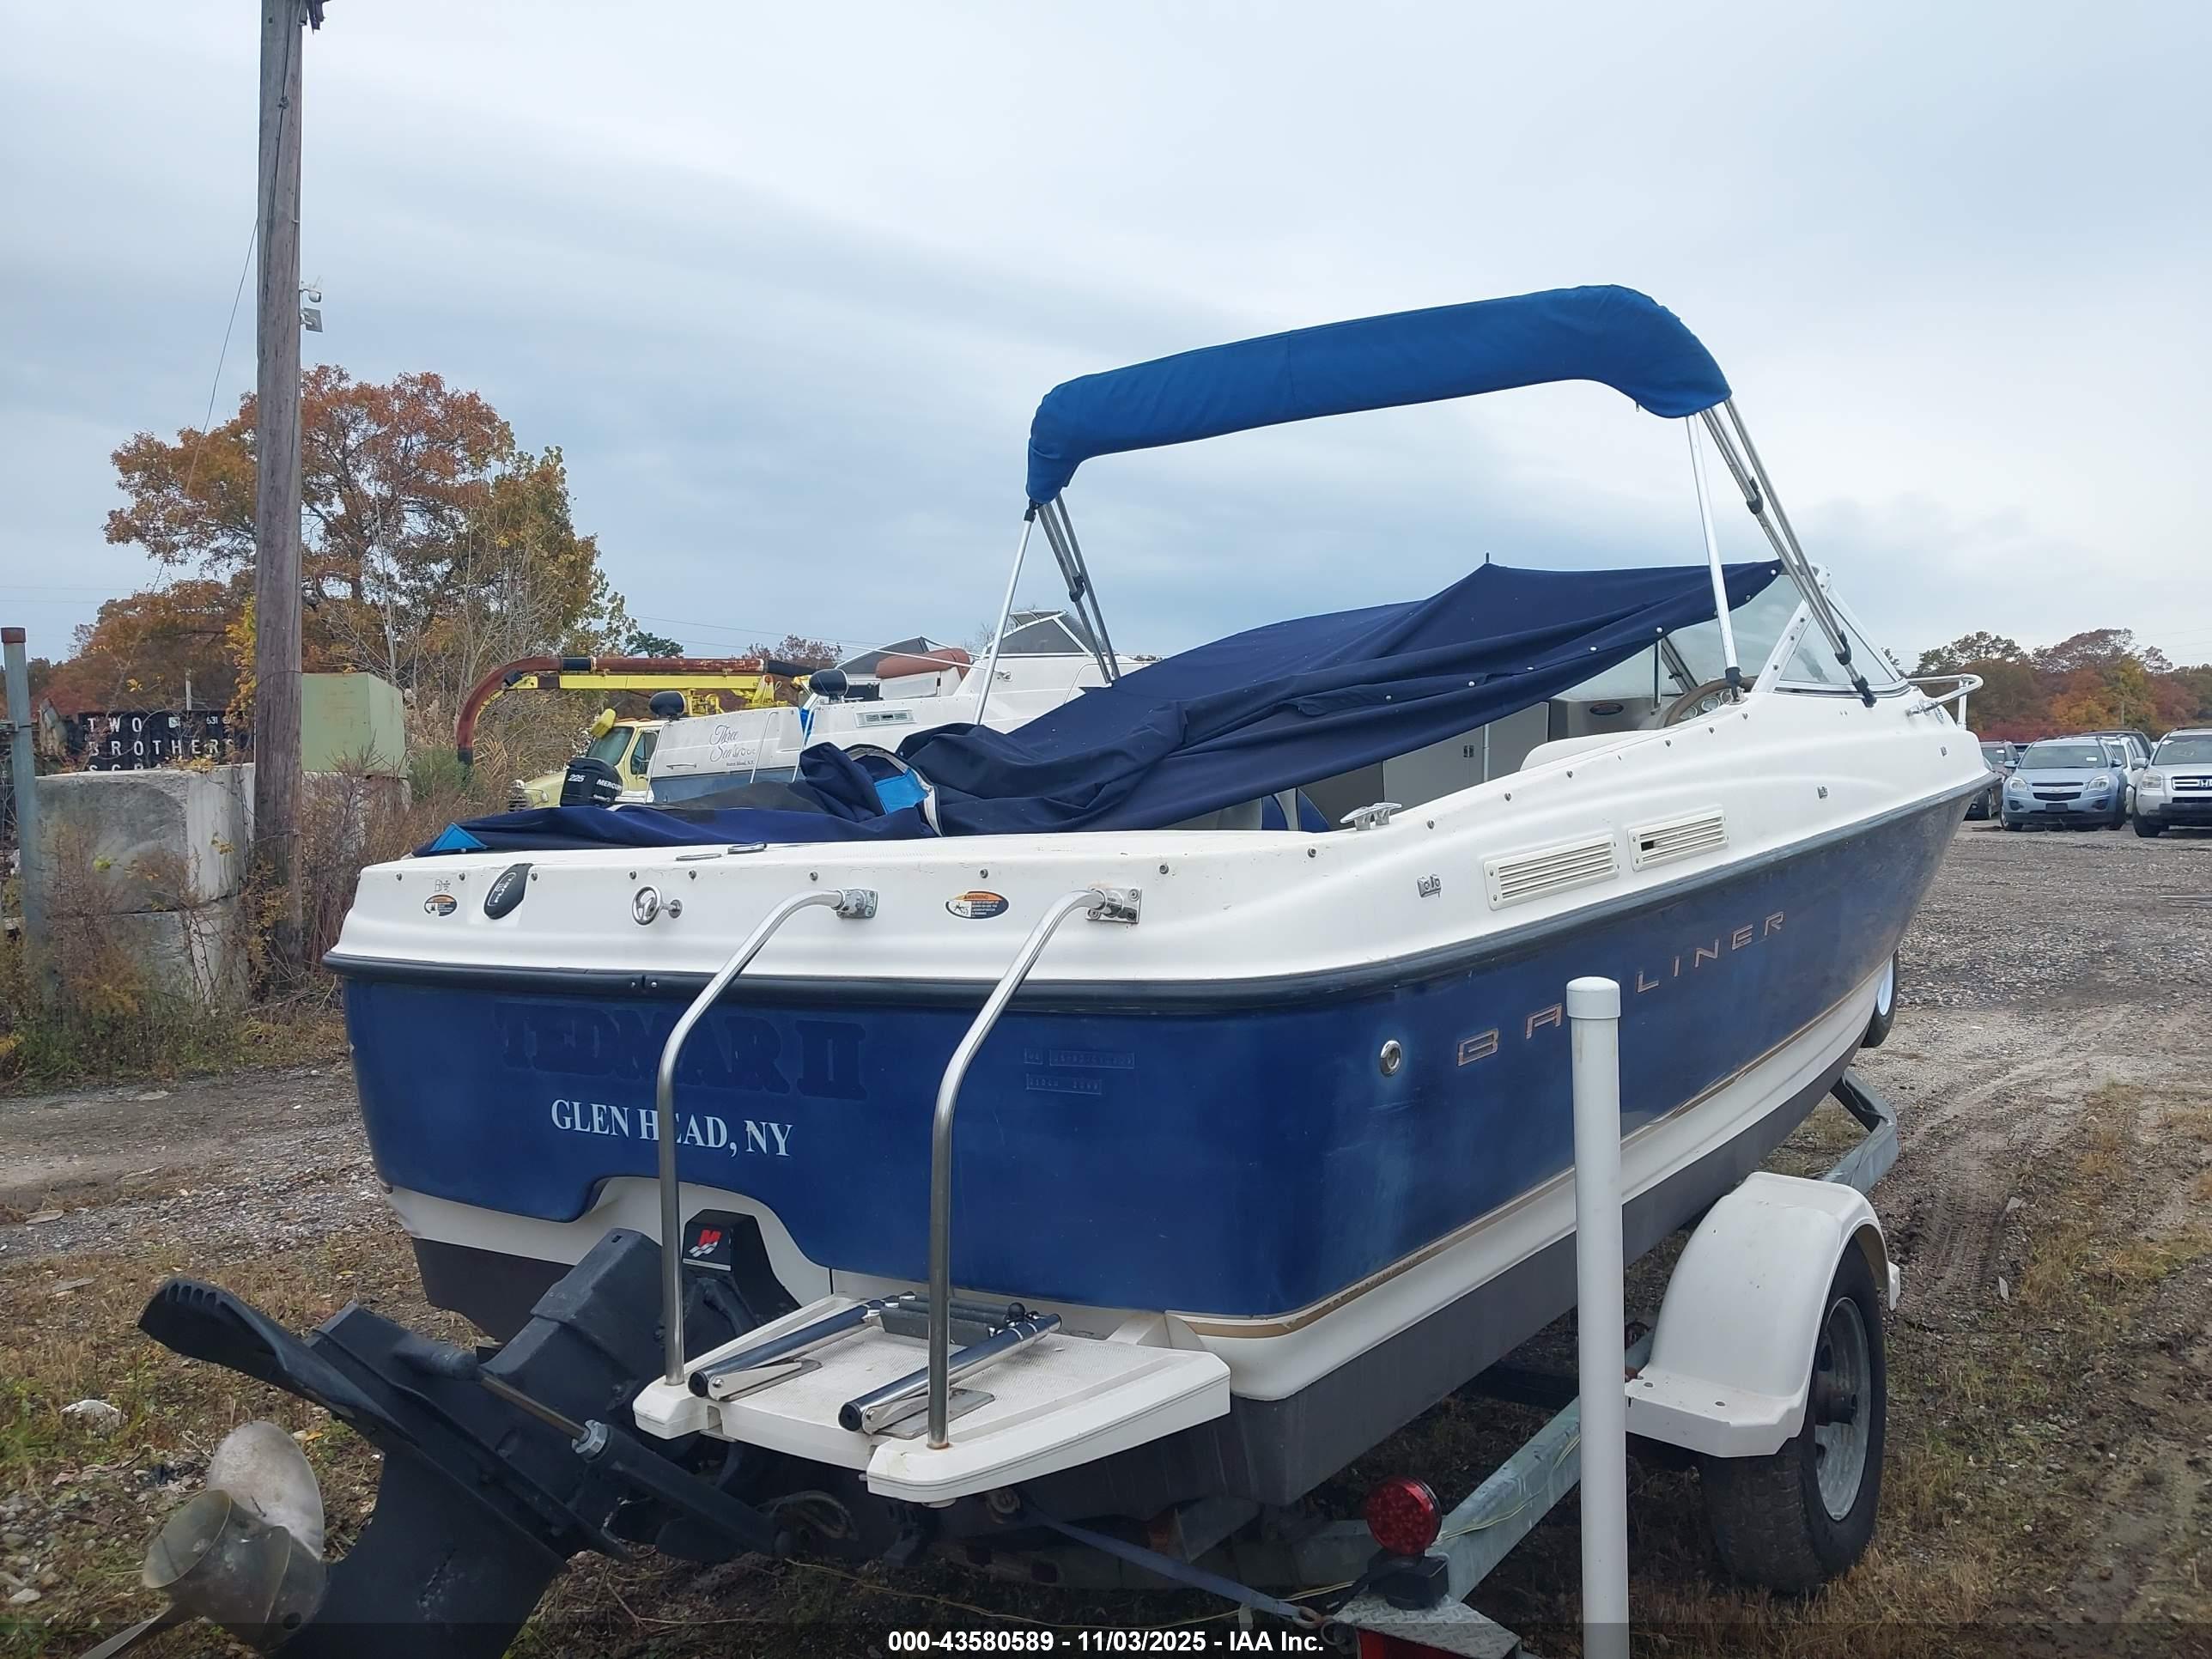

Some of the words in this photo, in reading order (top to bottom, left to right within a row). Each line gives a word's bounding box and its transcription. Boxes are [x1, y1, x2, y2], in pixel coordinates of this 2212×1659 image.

[87, 717, 143, 732] TWO
[568, 774, 586, 782] 225
[1457, 911, 1784, 1066] BALINER
[550, 1099, 629, 1138] GLEN
[638, 1108, 738, 1158] HAD,
[745, 1120, 794, 1157] NY
